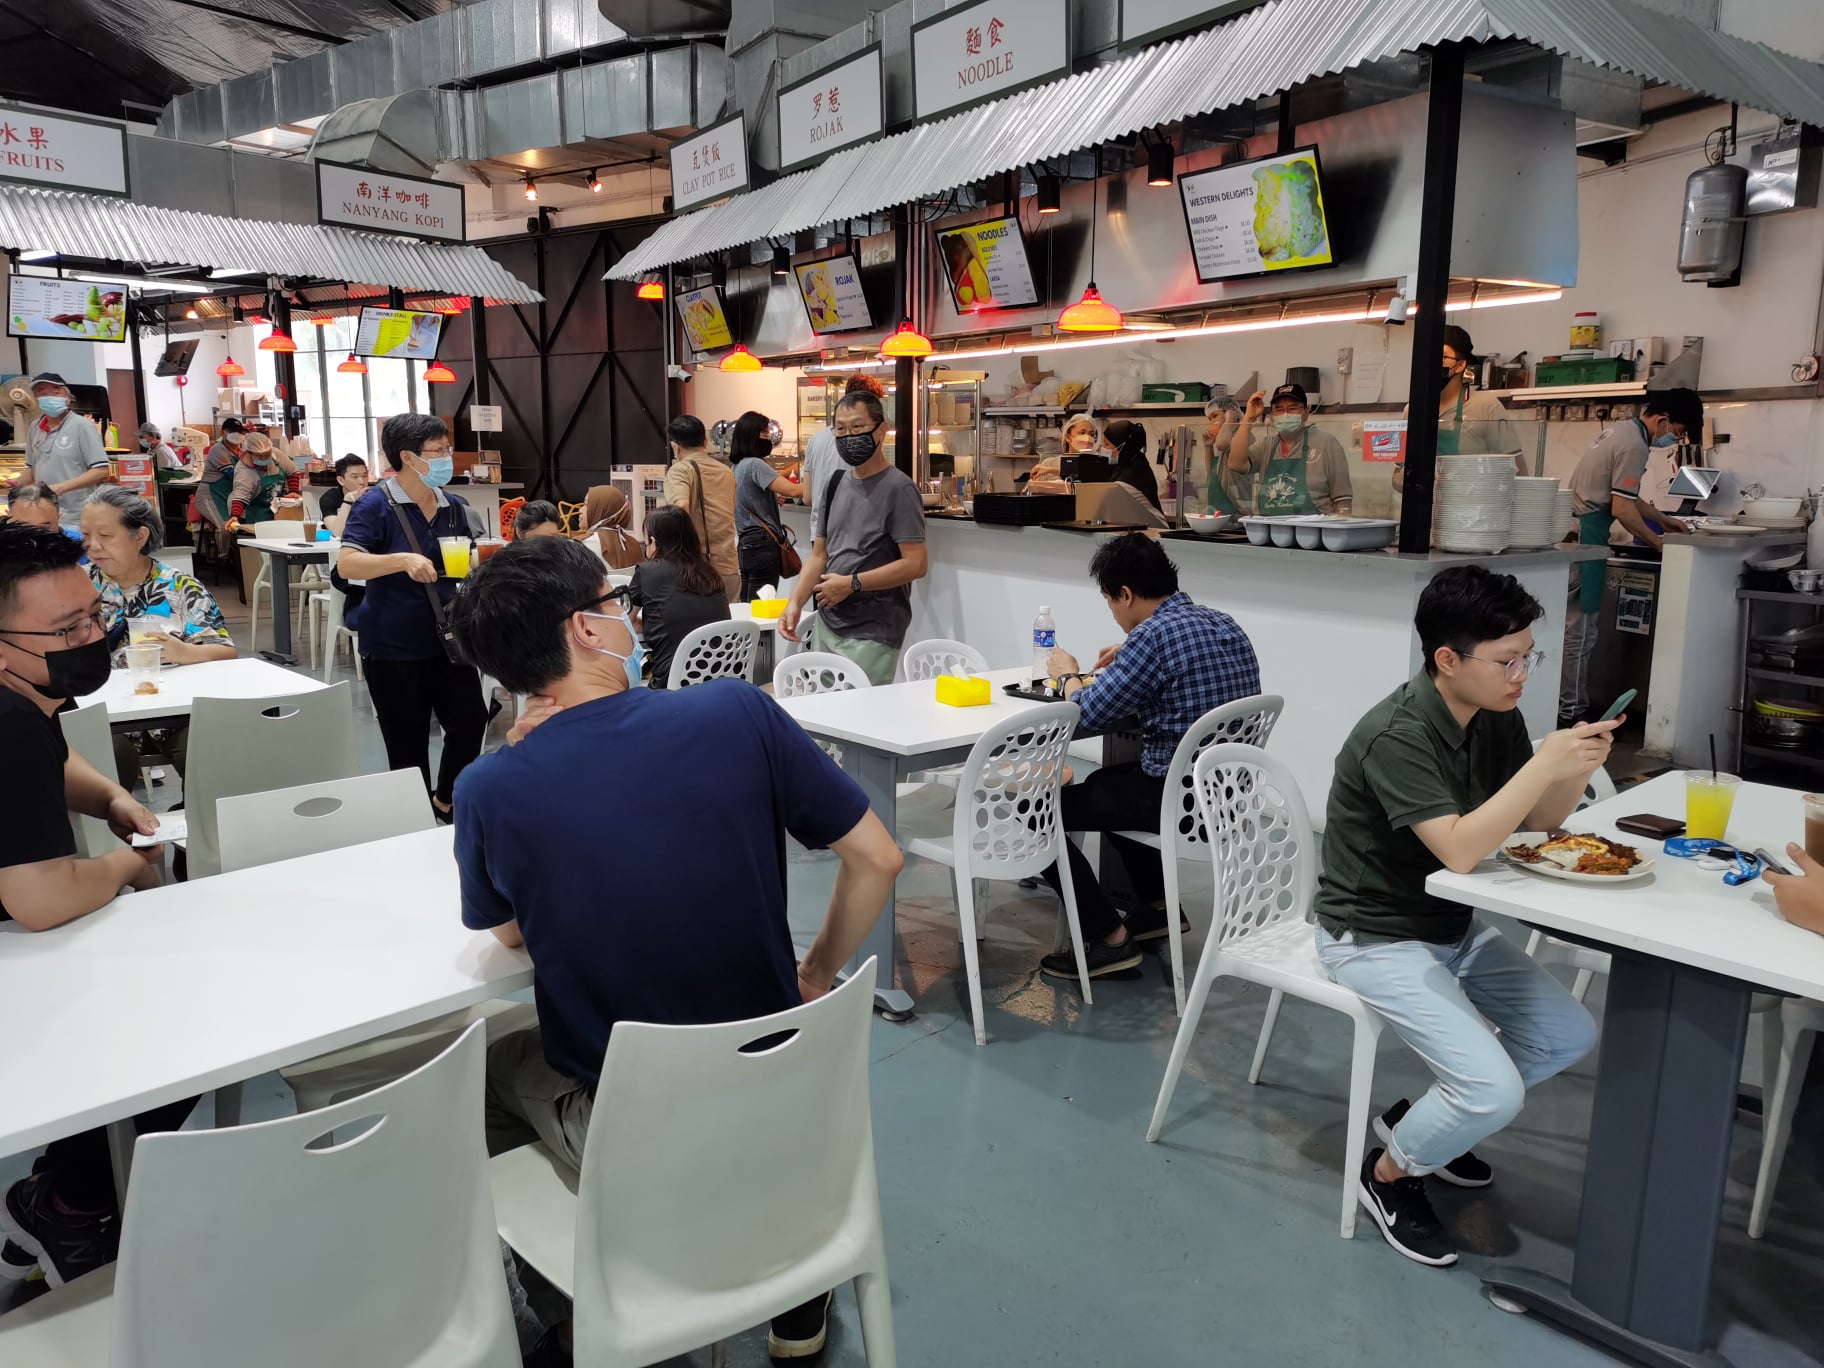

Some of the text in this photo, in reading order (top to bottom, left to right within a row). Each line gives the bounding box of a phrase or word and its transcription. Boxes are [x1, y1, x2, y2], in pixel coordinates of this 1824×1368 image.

[958, 51, 1013, 89] NOODLE
[0, 121, 49, 150] 水果
[809, 116, 844, 144] ROJAK
[682, 162, 736, 196] CLAY POT RICE
[356, 181, 430, 210] 南洋咖啡
[1189, 187, 1254, 208] WESTERN DELIGHTS
[342, 201, 444, 229] NANYANG KOPI
[1191, 214, 1218, 225] MAIN DISH
[977, 227, 1009, 241] NOODLES
[835, 273, 855, 286] ROJAK
